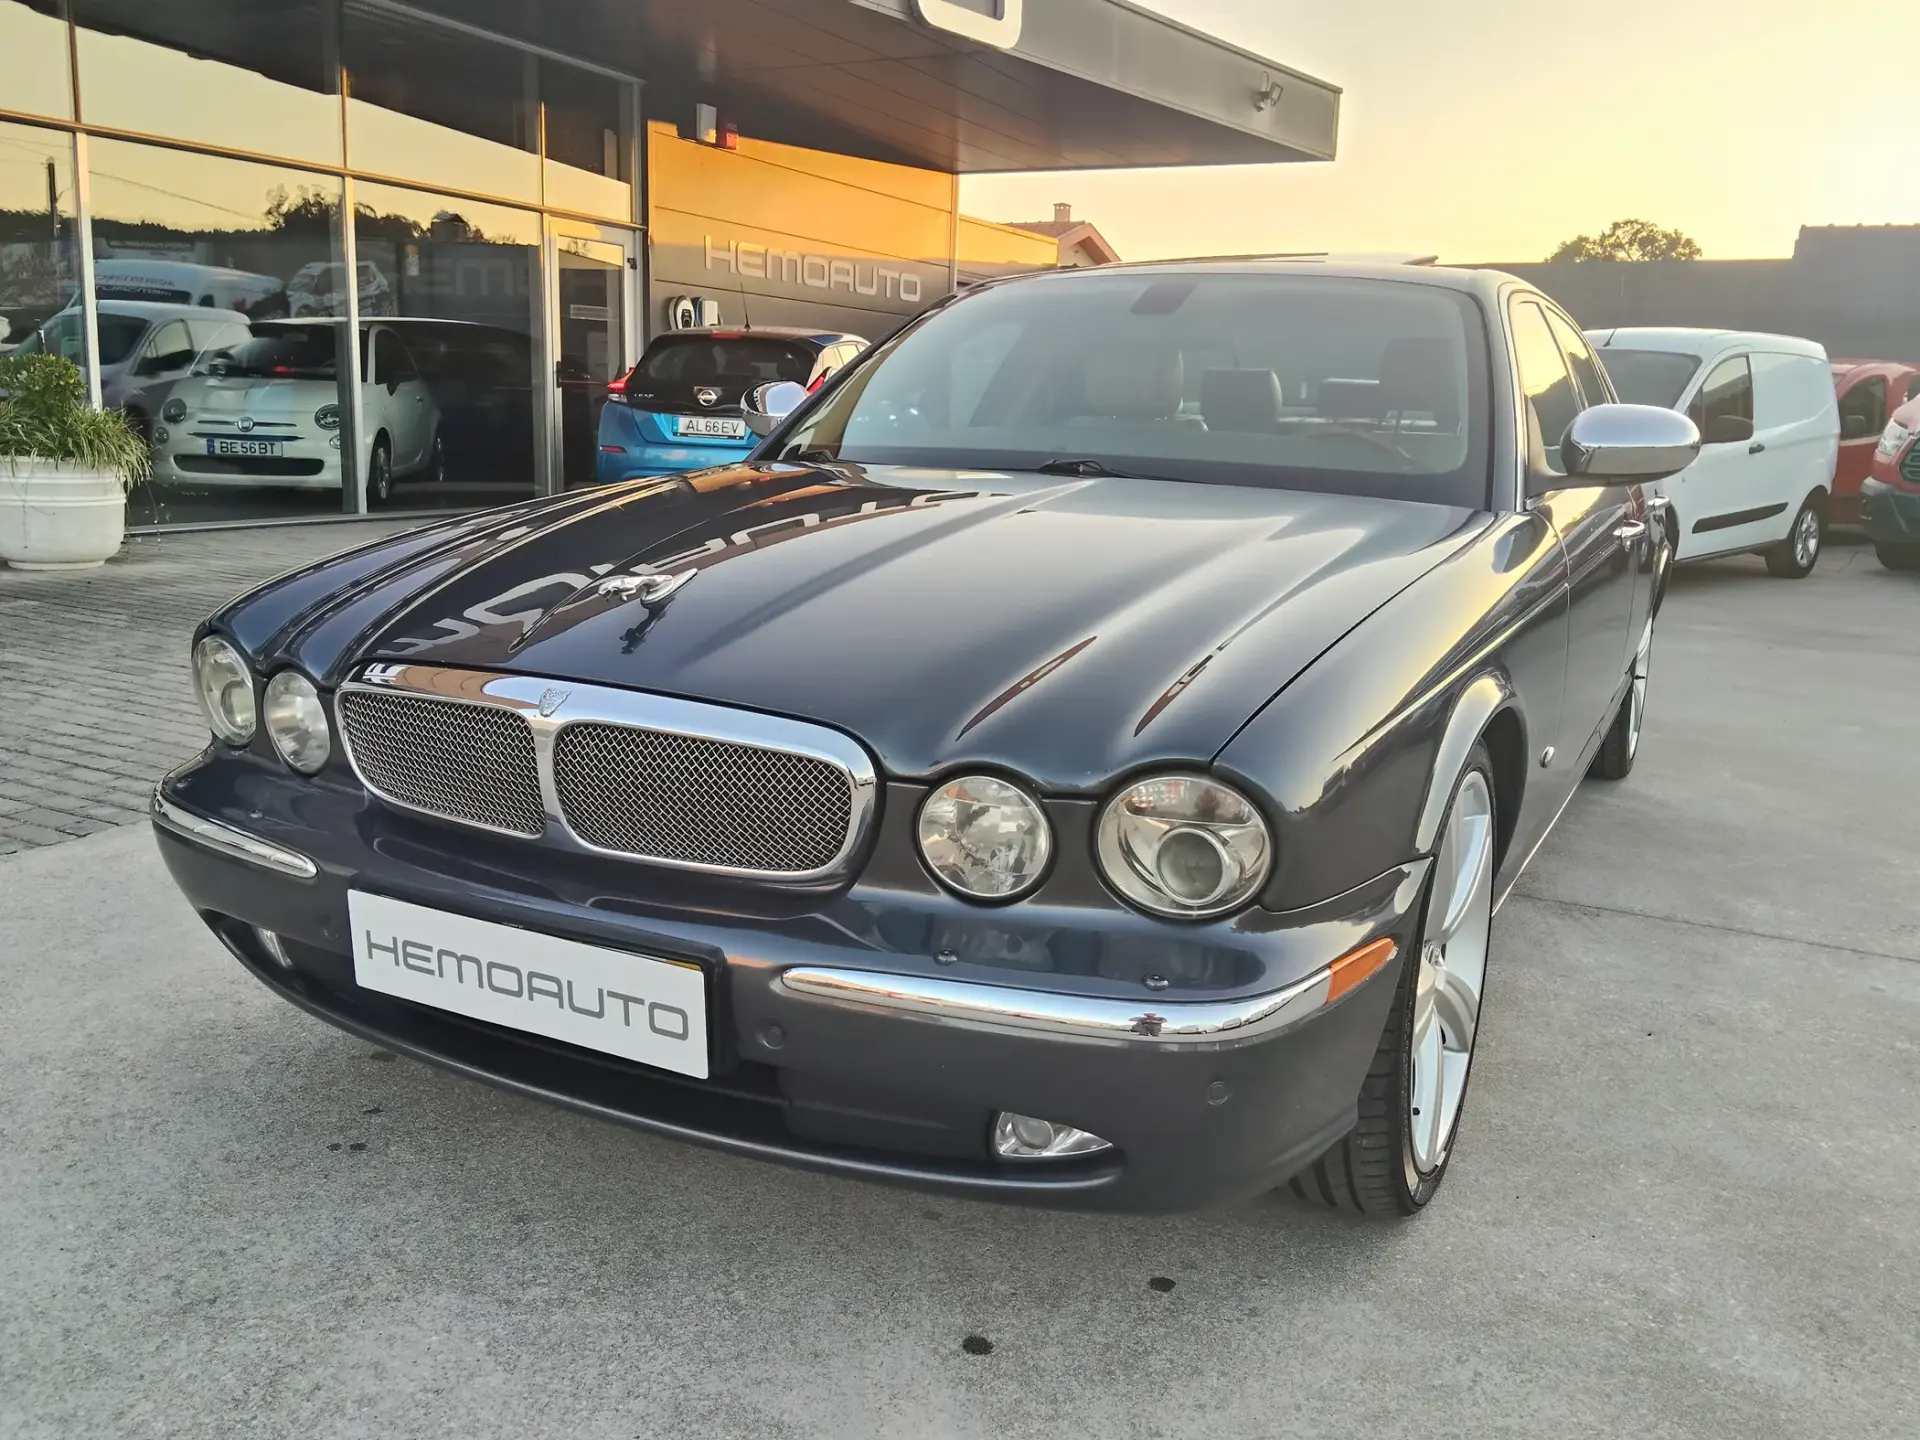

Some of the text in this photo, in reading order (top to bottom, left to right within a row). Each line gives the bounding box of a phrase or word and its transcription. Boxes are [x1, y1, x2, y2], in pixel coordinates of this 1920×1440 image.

[703, 234, 921, 302] HEMOAUTO
[220, 441, 275, 454] BE 56 BT
[685, 420, 740, 434] AL 66 EV
[365, 930, 689, 1041] HEMOAUTO
